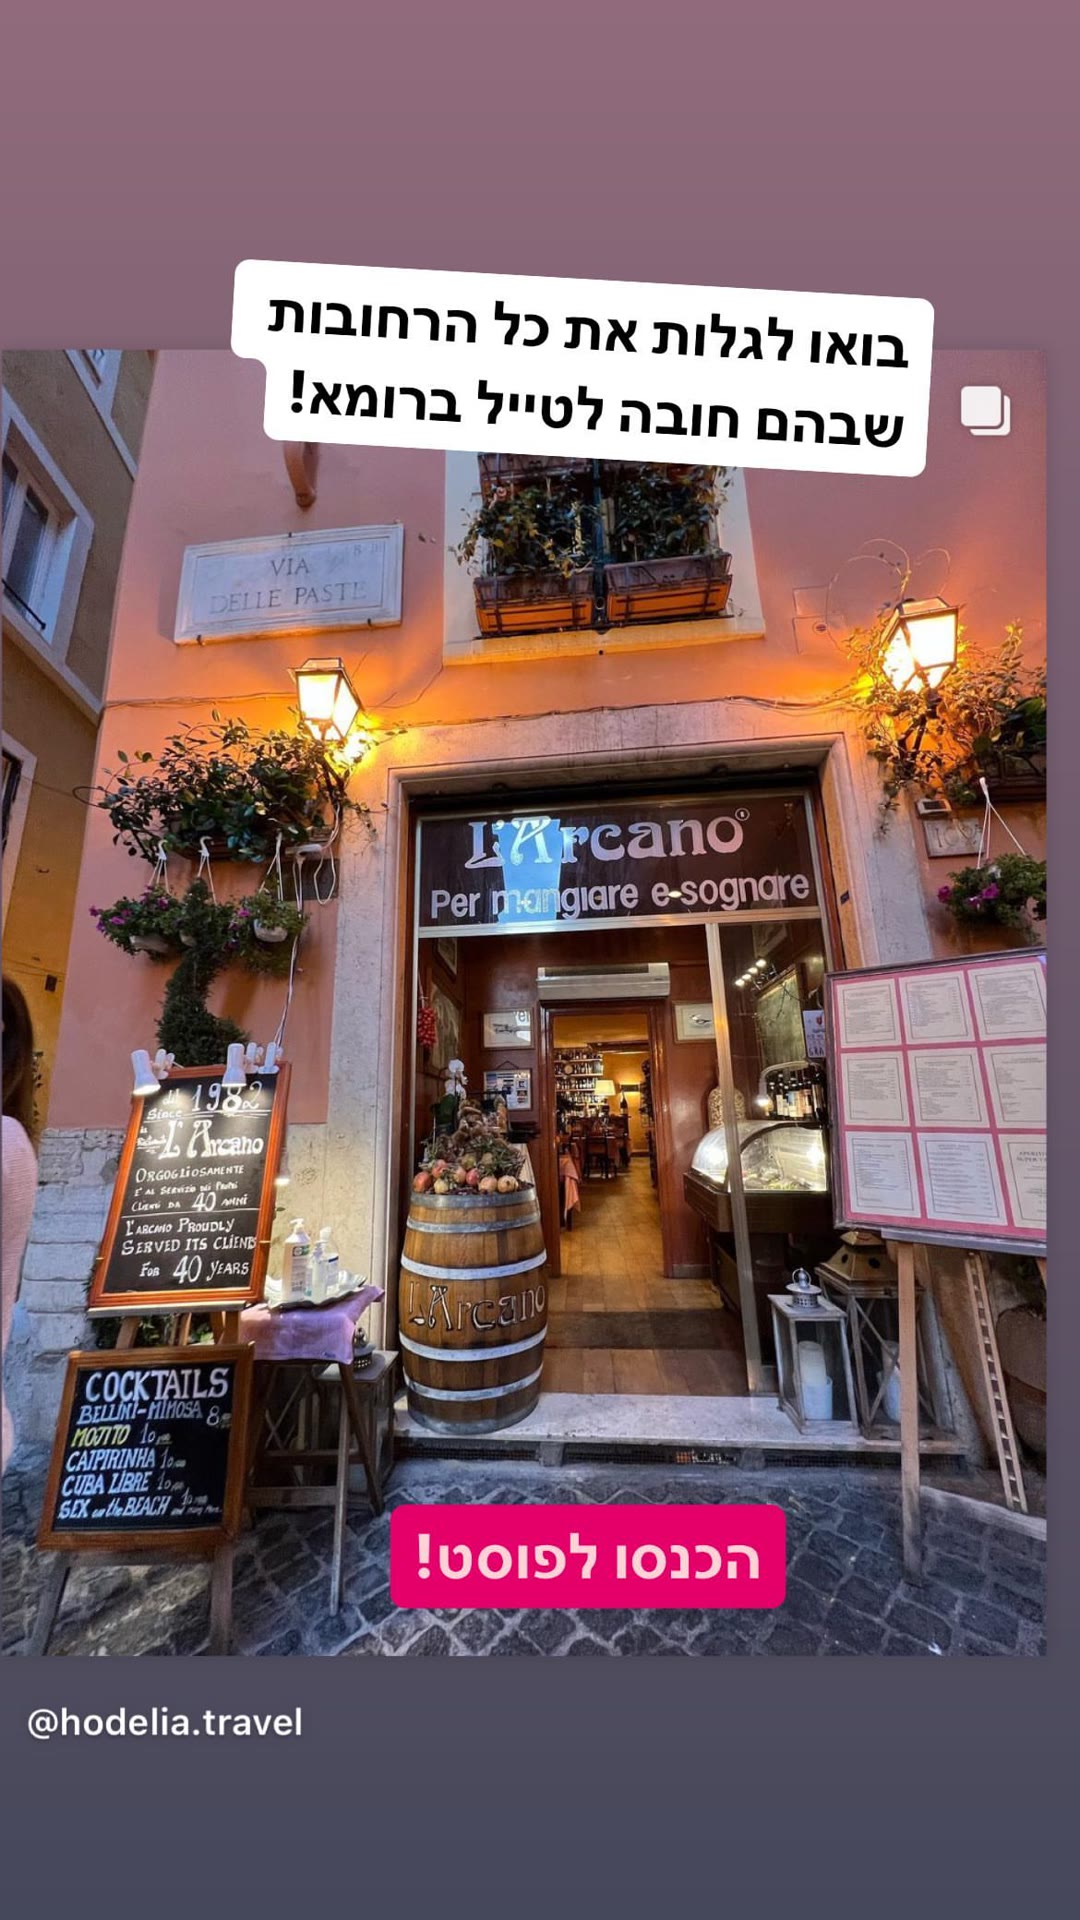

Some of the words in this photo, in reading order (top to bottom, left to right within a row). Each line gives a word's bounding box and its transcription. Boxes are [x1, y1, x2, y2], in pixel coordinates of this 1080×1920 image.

[271, 558, 311, 576] VIA
[209, 588, 282, 614] DELLE
[431, 889, 481, 919] Per
[492, 884, 639, 920] mangiare
[652, 882, 670, 907] e
[680, 874, 810, 911] sognare
[191, 1081, 263, 1112] 1982
[191, 1191, 217, 1212] 40
[177, 1217, 235, 1233] PROUDLY
[121, 1239, 180, 1255] SERVED
[185, 1238, 208, 1251] ITS
[172, 1255, 203, 1284] 40
[206, 1260, 250, 1281] YEARS
[85, 1367, 230, 1402] COCKTAILS
[70, 1424, 131, 1447] MOJITO
[65, 1447, 156, 1472] CAIPIRINHA
[61, 1473, 105, 1497] CUBA
[108, 1469, 152, 1494] LIBRE
[57, 1498, 92, 1519] SEX
[122, 1495, 172, 1516] BEACH
